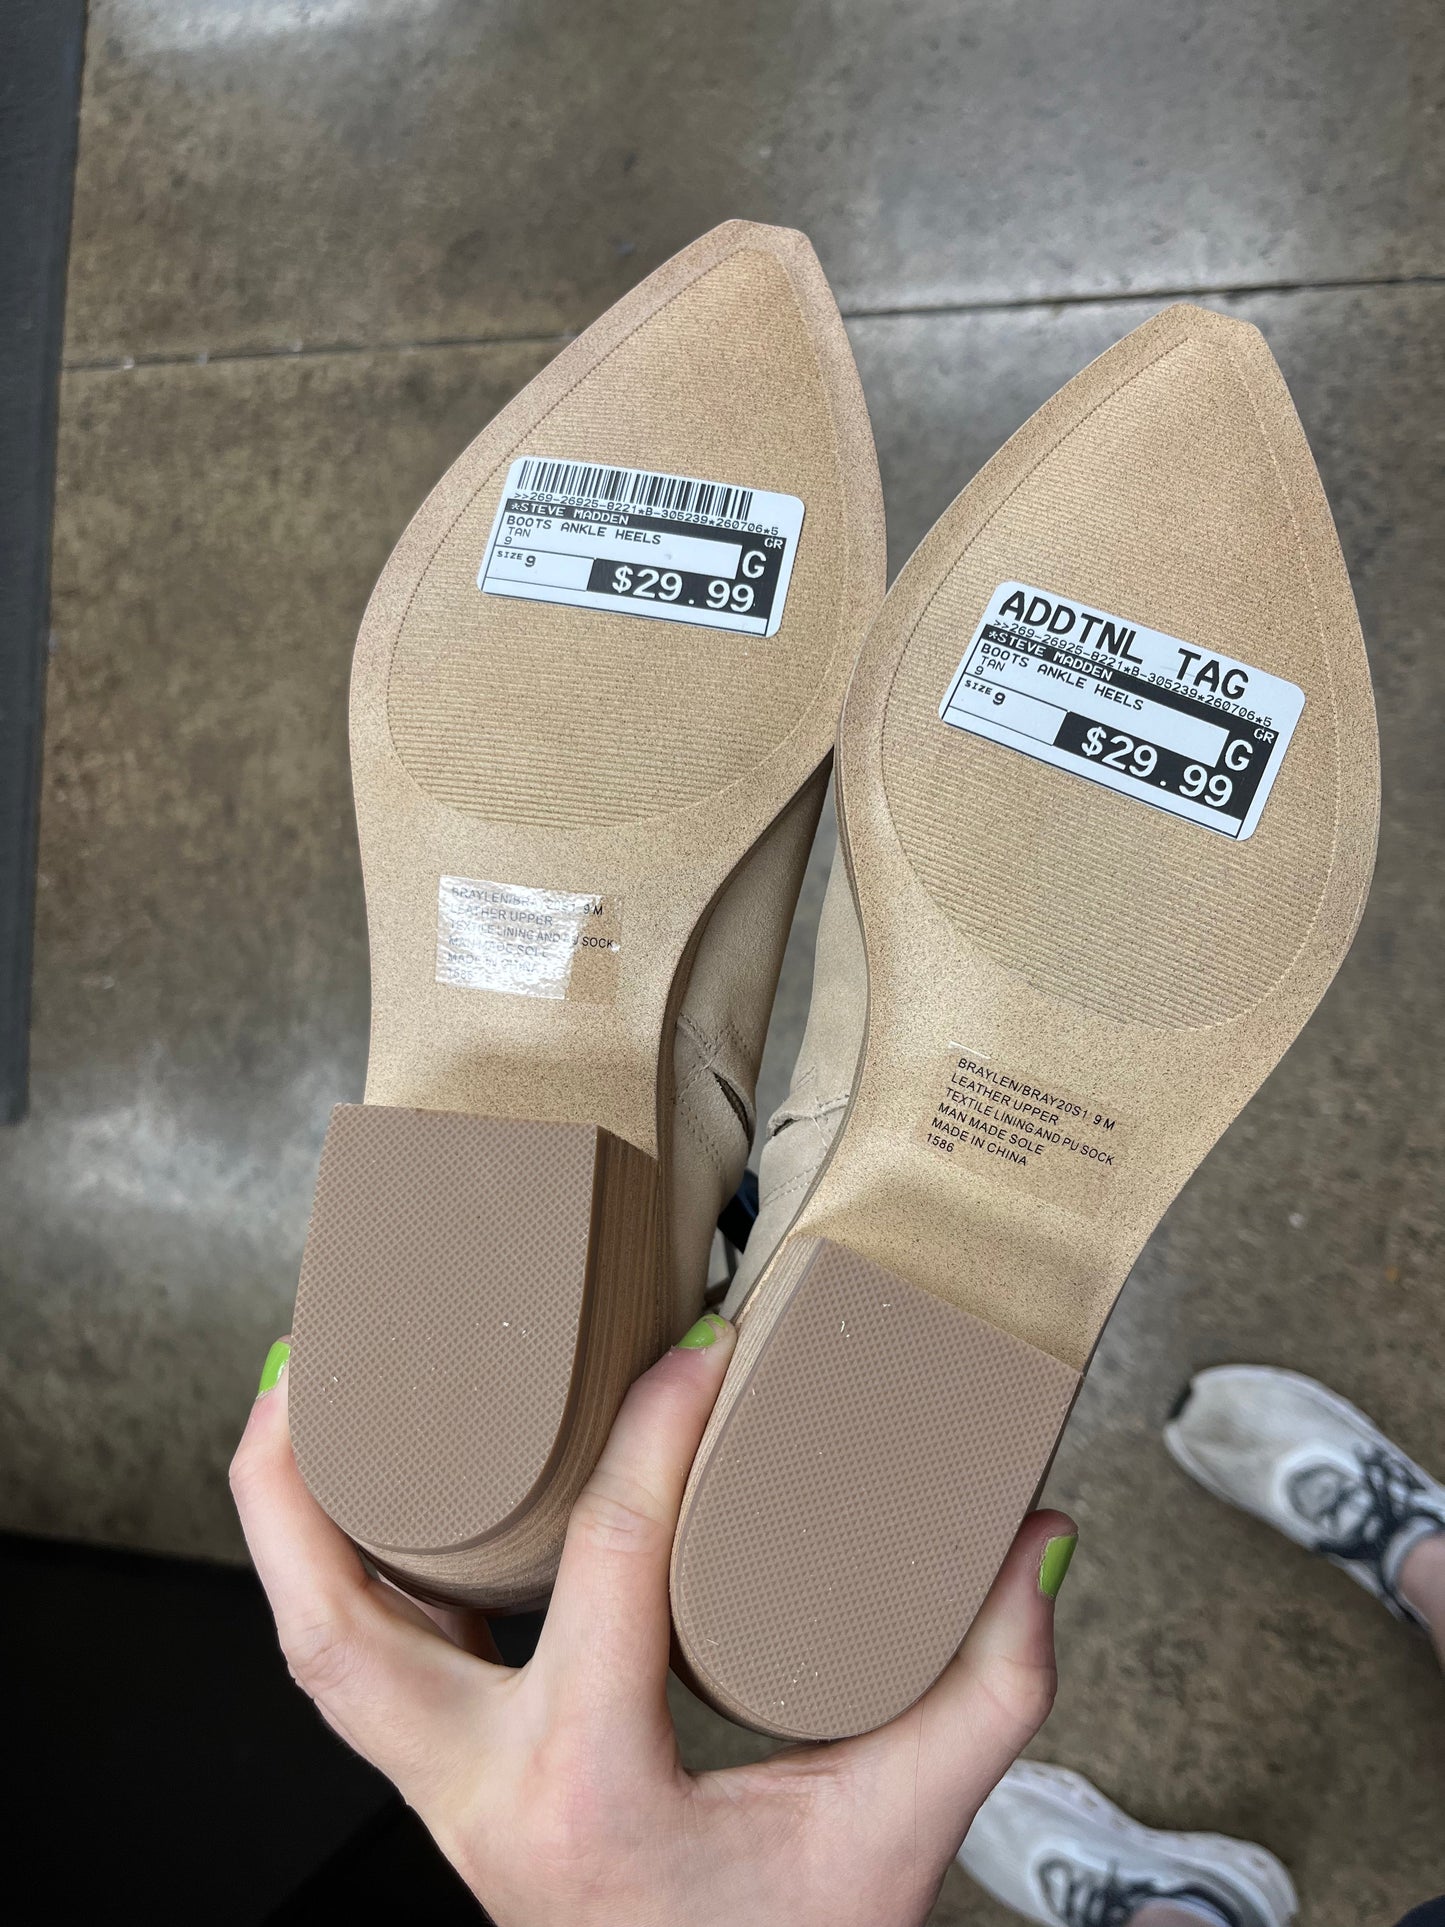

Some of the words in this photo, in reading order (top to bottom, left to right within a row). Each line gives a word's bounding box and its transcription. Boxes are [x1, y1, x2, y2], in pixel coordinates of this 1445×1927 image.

[506, 515, 552, 530] BOOTS
[560, 522, 607, 537] ANKLE
[615, 529, 662, 545] HEELS
[573, 509, 629, 525] MADDEN
[503, 536, 512, 546] 9
[509, 527, 531, 538] TAN
[764, 537, 784, 549] GR
[496, 550, 523, 560] SIZE
[524, 555, 537, 568] 9
[742, 550, 767, 579] G
[612, 565, 755, 613] $29.99
[998, 590, 1143, 665] ADDTNL
[1177, 647, 1249, 700] TAG
[974, 666, 984, 676] 9
[980, 656, 1006, 672] TAN
[980, 643, 1030, 667] BOOTS
[1036, 663, 1087, 689] ANKLE
[1094, 683, 1144, 711] HEELS
[1053, 651, 1113, 681] MADDEN
[964, 679, 993, 695] SIZE
[992, 691, 1006, 706] 9
[1253, 727, 1275, 744] GR
[1081, 725, 1233, 808] $29.99
[1224, 738, 1253, 772] G
[510, 911, 554, 926] UPPER
[583, 903, 590, 915] 9
[593, 904, 603, 916] M
[582, 936, 615, 949] SOCK
[951, 1072, 1011, 1107] LEATHER
[1013, 1099, 1060, 1126] UPPER
[958, 1057, 1089, 1119] BRAYLEN/BRAY20S1
[1093, 1114, 1103, 1126] 9
[1104, 1117, 1116, 1131] M
[938, 1102, 968, 1123] MAN
[968, 1116, 1006, 1140] MADE
[1008, 1133, 1045, 1156] SOLE
[946, 1087, 992, 1116] TEXTILE
[994, 1110, 1036, 1133] LINING
[1034, 1127, 1061, 1144] AND
[1061, 1136, 1080, 1151] PU
[1080, 1145, 1116, 1166] SOCK
[926, 1132, 955, 1153] 1586
[931, 1117, 970, 1142] MADE
[970, 1135, 986, 1149] IN
[987, 1142, 1029, 1167] CHINA
